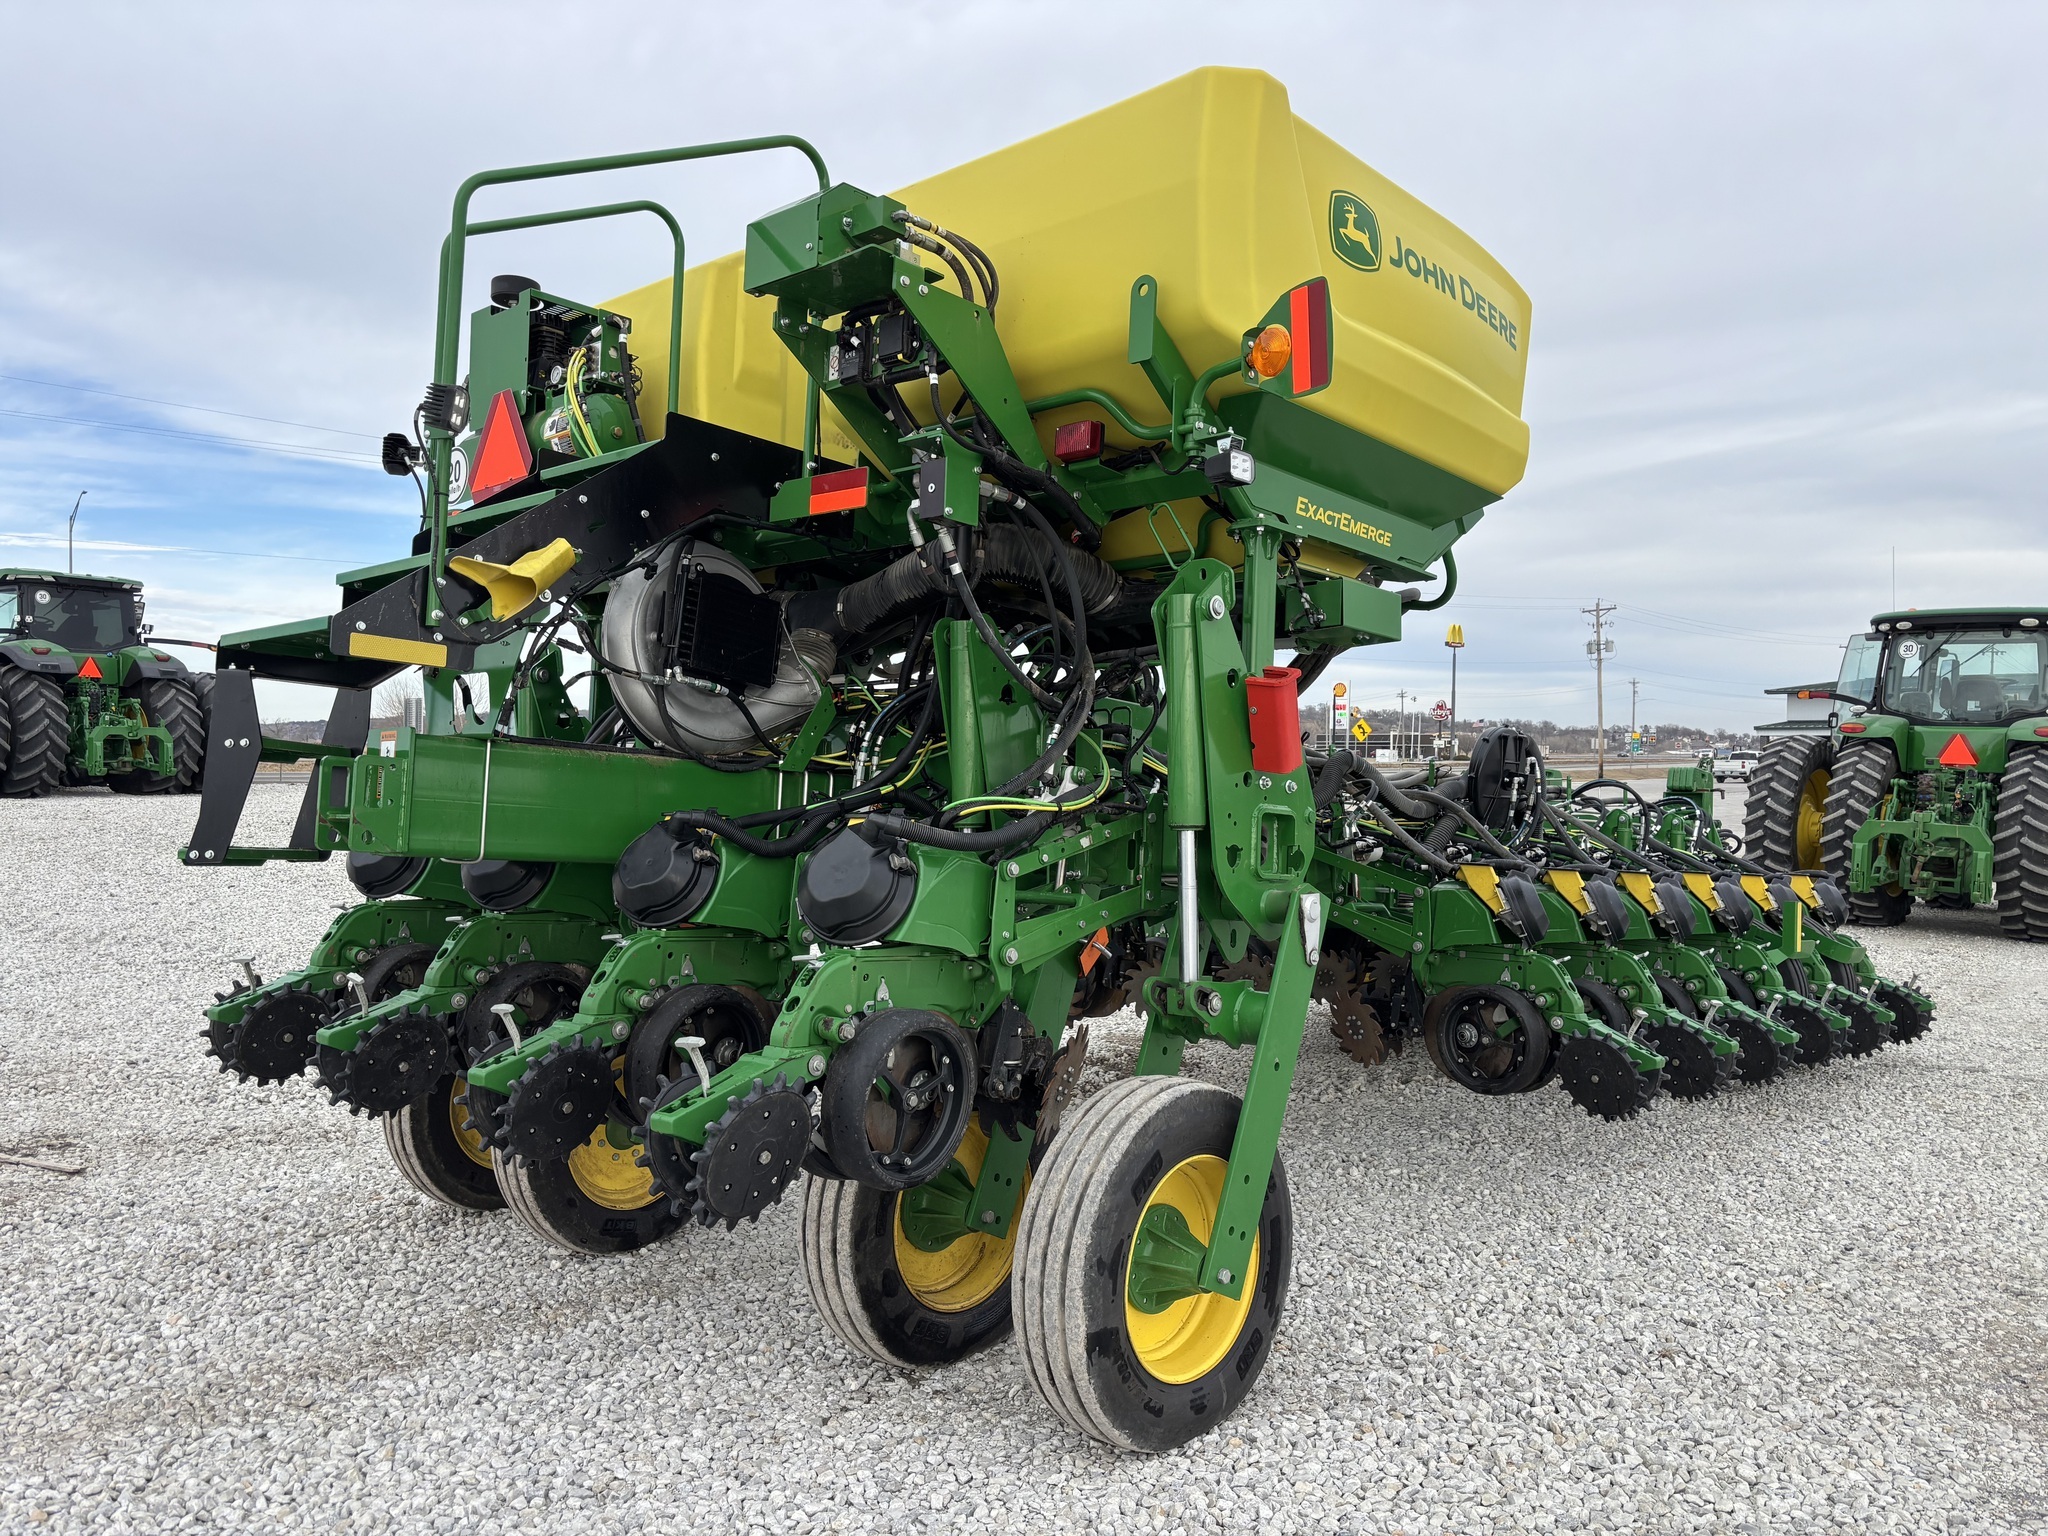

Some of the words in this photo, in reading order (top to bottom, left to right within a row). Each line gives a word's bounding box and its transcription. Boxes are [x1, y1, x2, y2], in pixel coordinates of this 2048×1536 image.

[1389, 235, 1456, 301] JOHN
[1459, 274, 1517, 352] DEERE
[1295, 495, 1393, 547] EXACTEMERGE
[1903, 644, 1914, 653] 30
